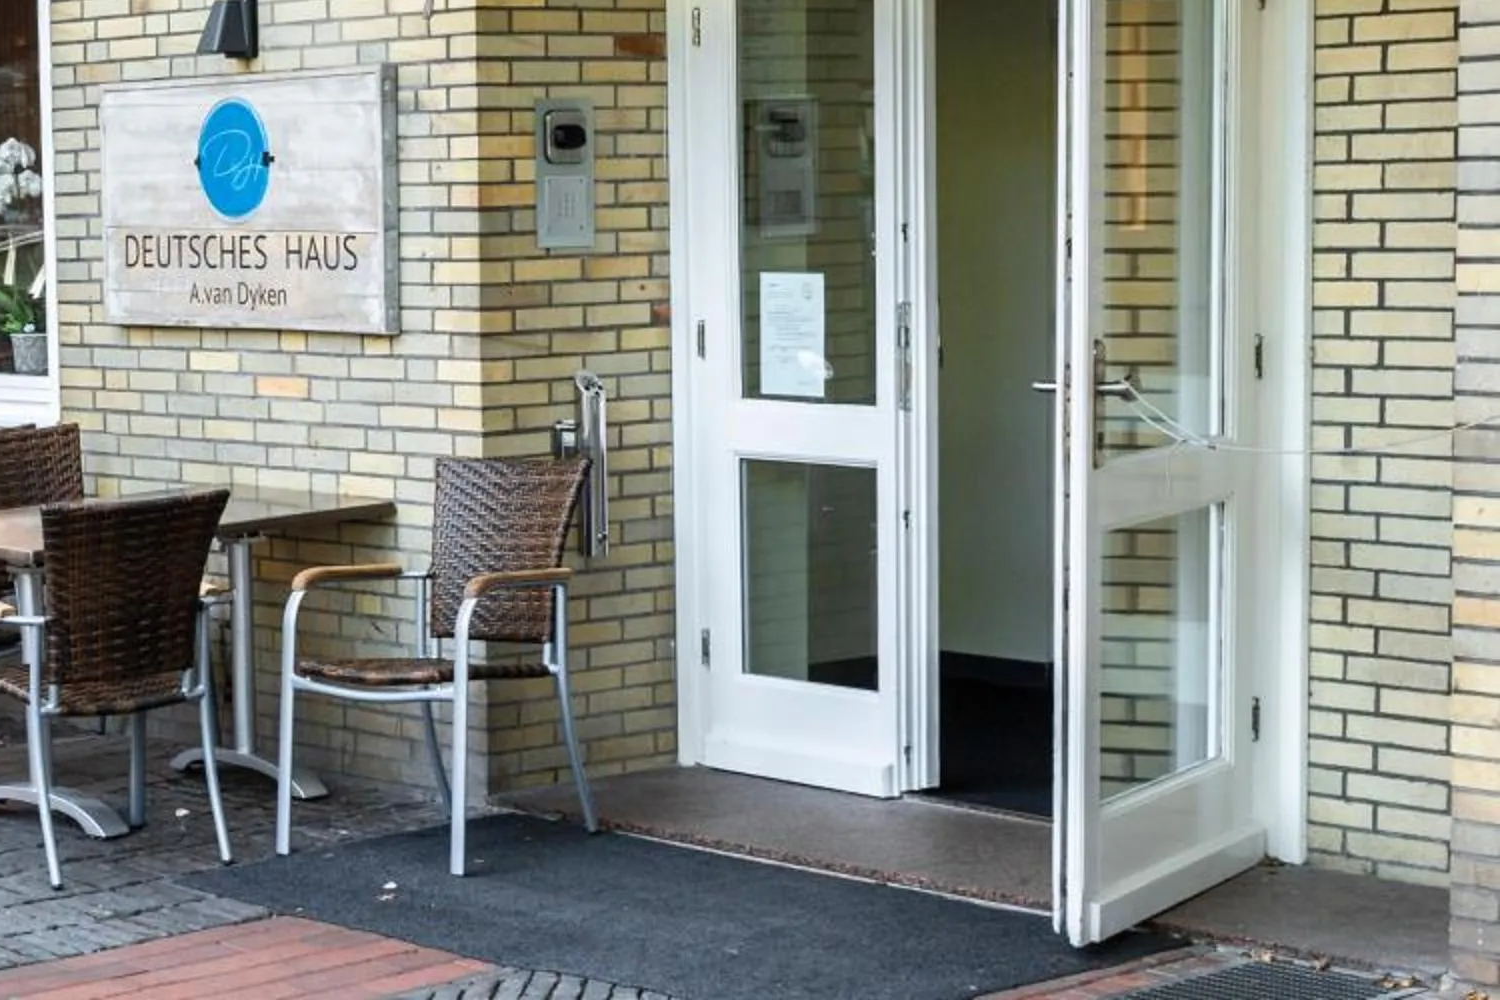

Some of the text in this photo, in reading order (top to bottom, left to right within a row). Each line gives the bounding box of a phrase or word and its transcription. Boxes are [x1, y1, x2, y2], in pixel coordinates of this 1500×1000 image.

[125, 235, 359, 271] DEUTSCHES HAUS
[237, 282, 288, 311] Dyken
